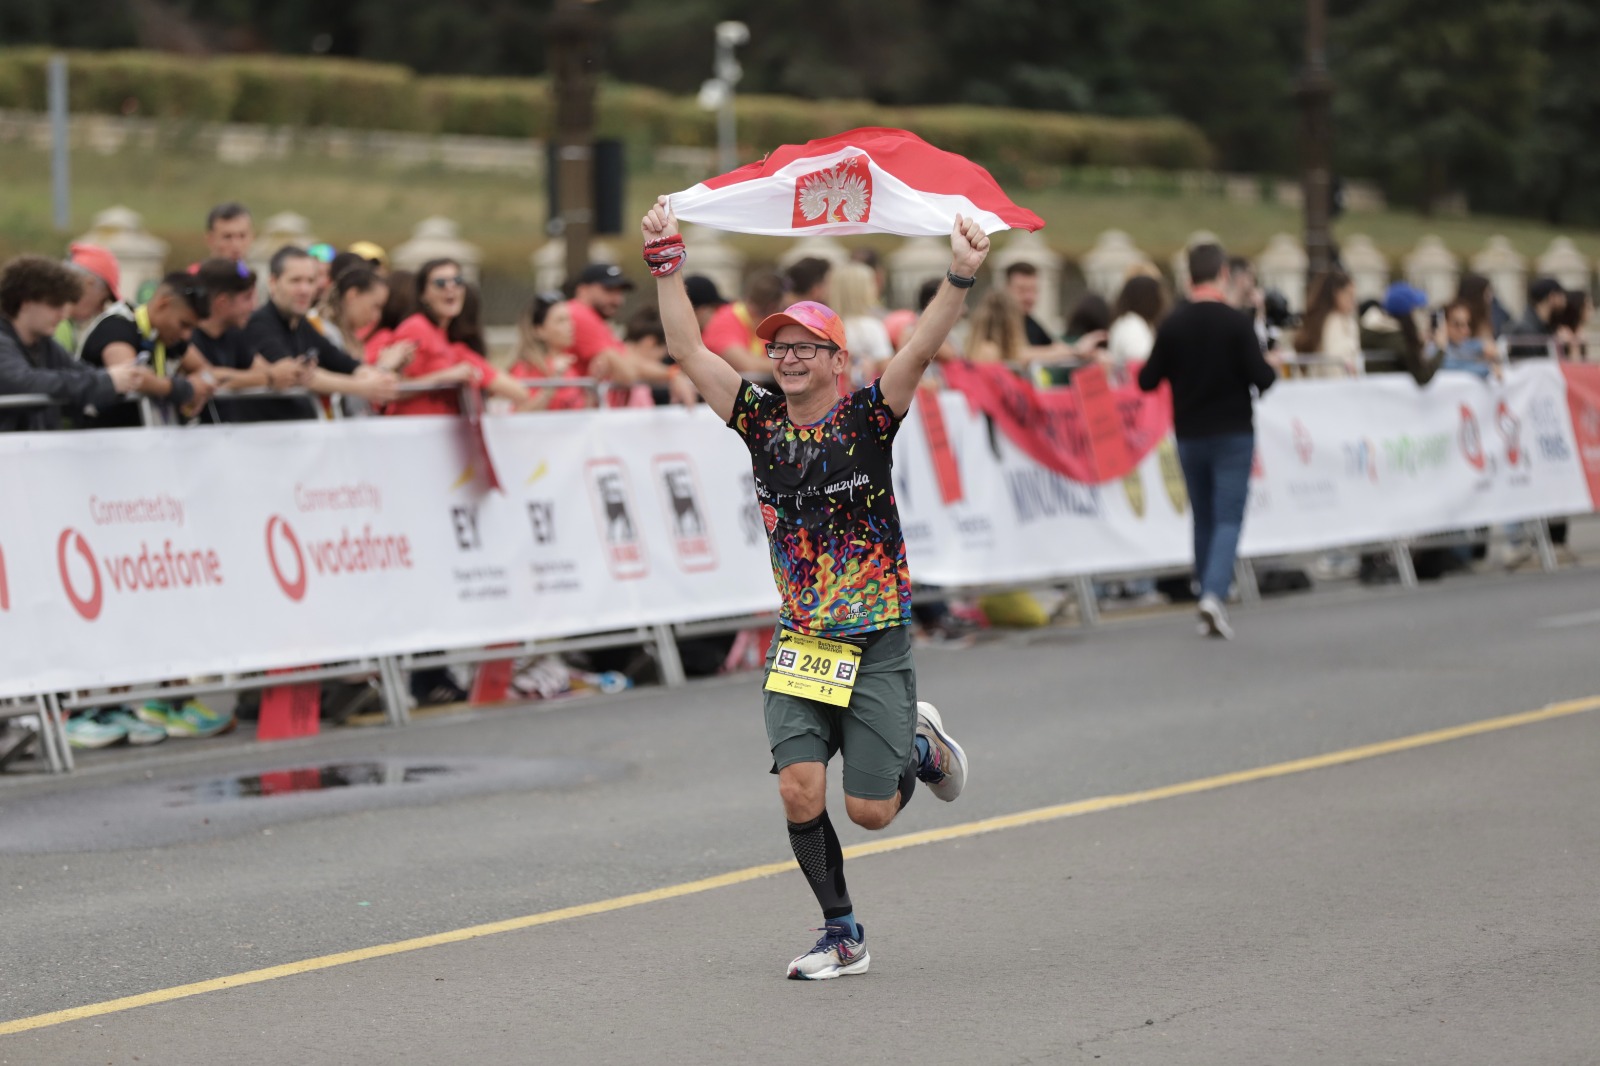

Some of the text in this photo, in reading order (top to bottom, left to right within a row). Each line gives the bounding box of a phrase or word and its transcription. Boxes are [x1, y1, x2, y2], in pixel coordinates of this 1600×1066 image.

[824, 471, 870, 502] muzyka
[89, 493, 185, 527] Connected by
[104, 541, 222, 592] vodafone
[308, 524, 413, 575] vodafone
[800, 654, 832, 676] 249
